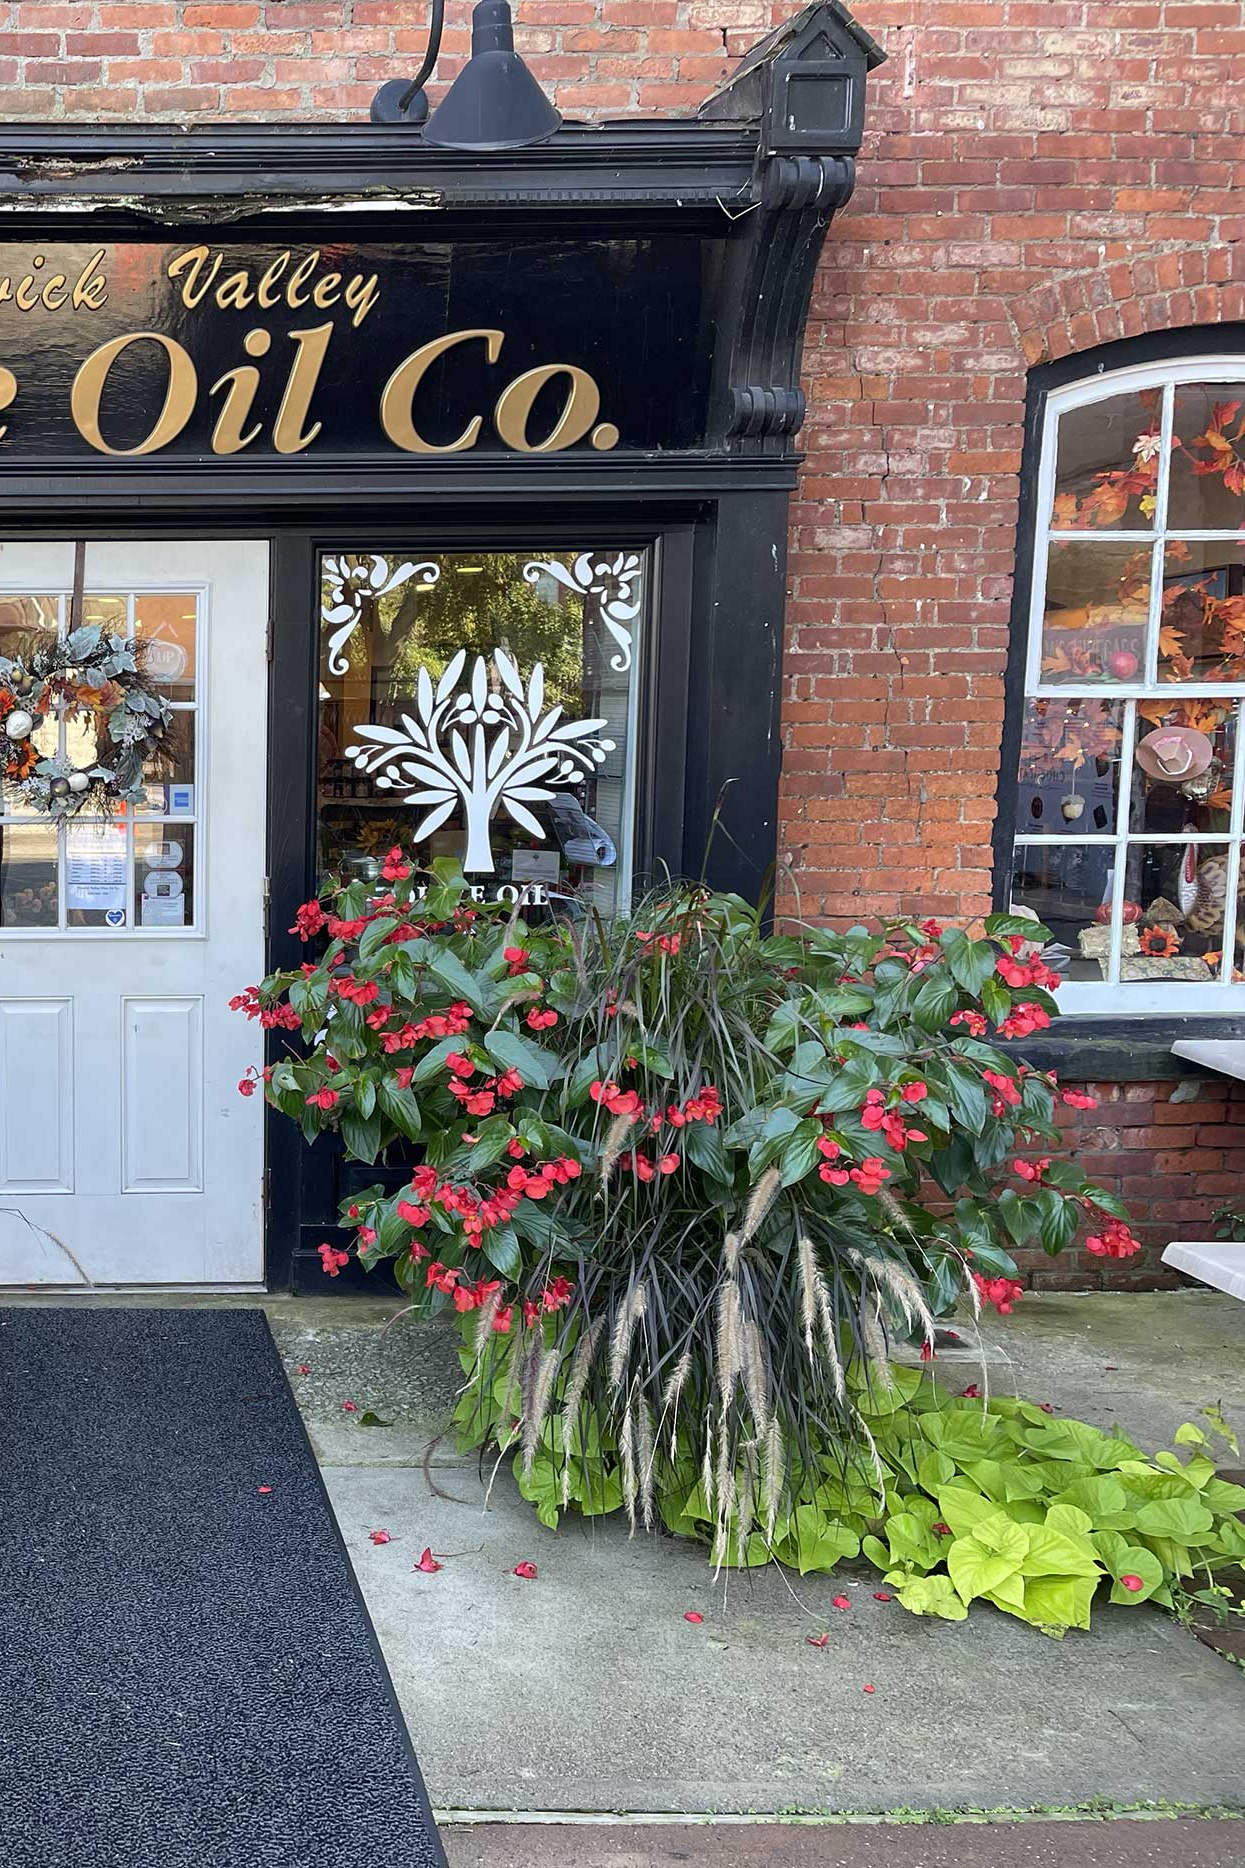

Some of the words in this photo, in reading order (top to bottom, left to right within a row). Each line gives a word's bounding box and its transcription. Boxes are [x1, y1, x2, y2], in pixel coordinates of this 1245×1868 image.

[168, 245, 382, 325] Valley
[71, 321, 334, 457] Oil
[380, 328, 621, 453] Co.
